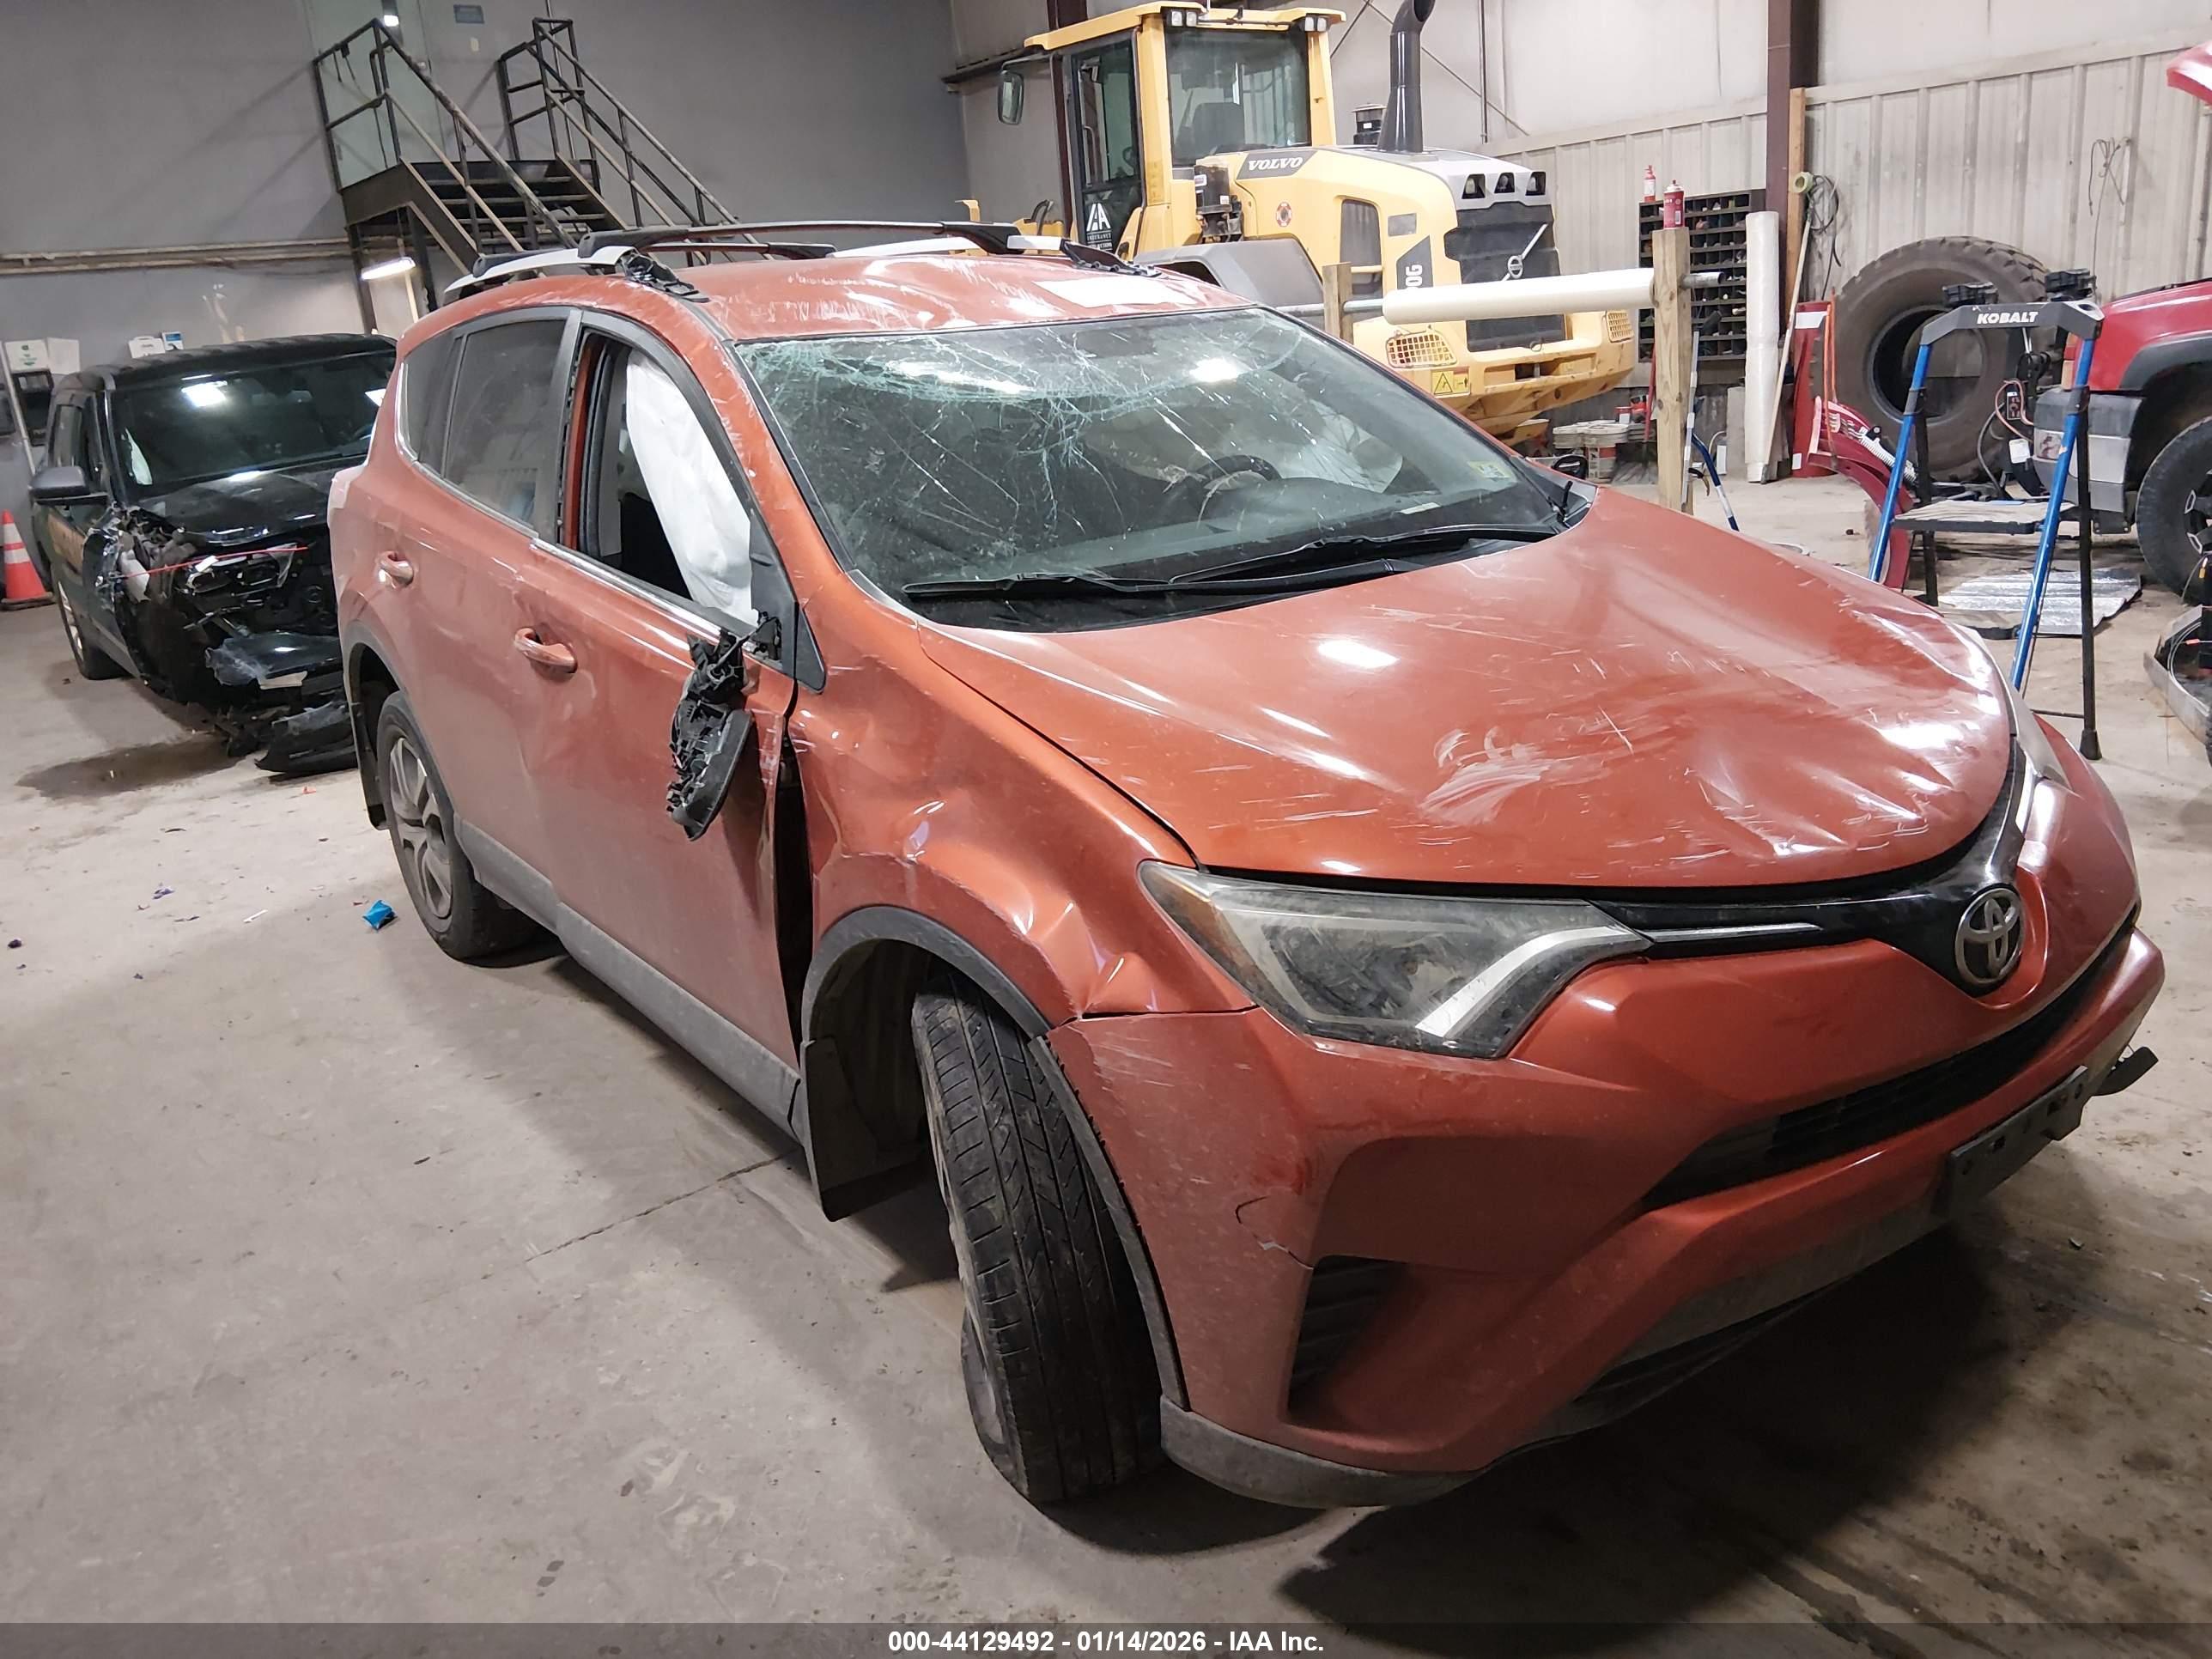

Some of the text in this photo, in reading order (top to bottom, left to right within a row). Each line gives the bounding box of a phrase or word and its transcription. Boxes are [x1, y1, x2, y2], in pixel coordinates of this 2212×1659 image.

[1248, 156, 1304, 171] VOLVO
[1405, 264, 1423, 288] 0G
[1977, 311, 2039, 325] KOBALT
